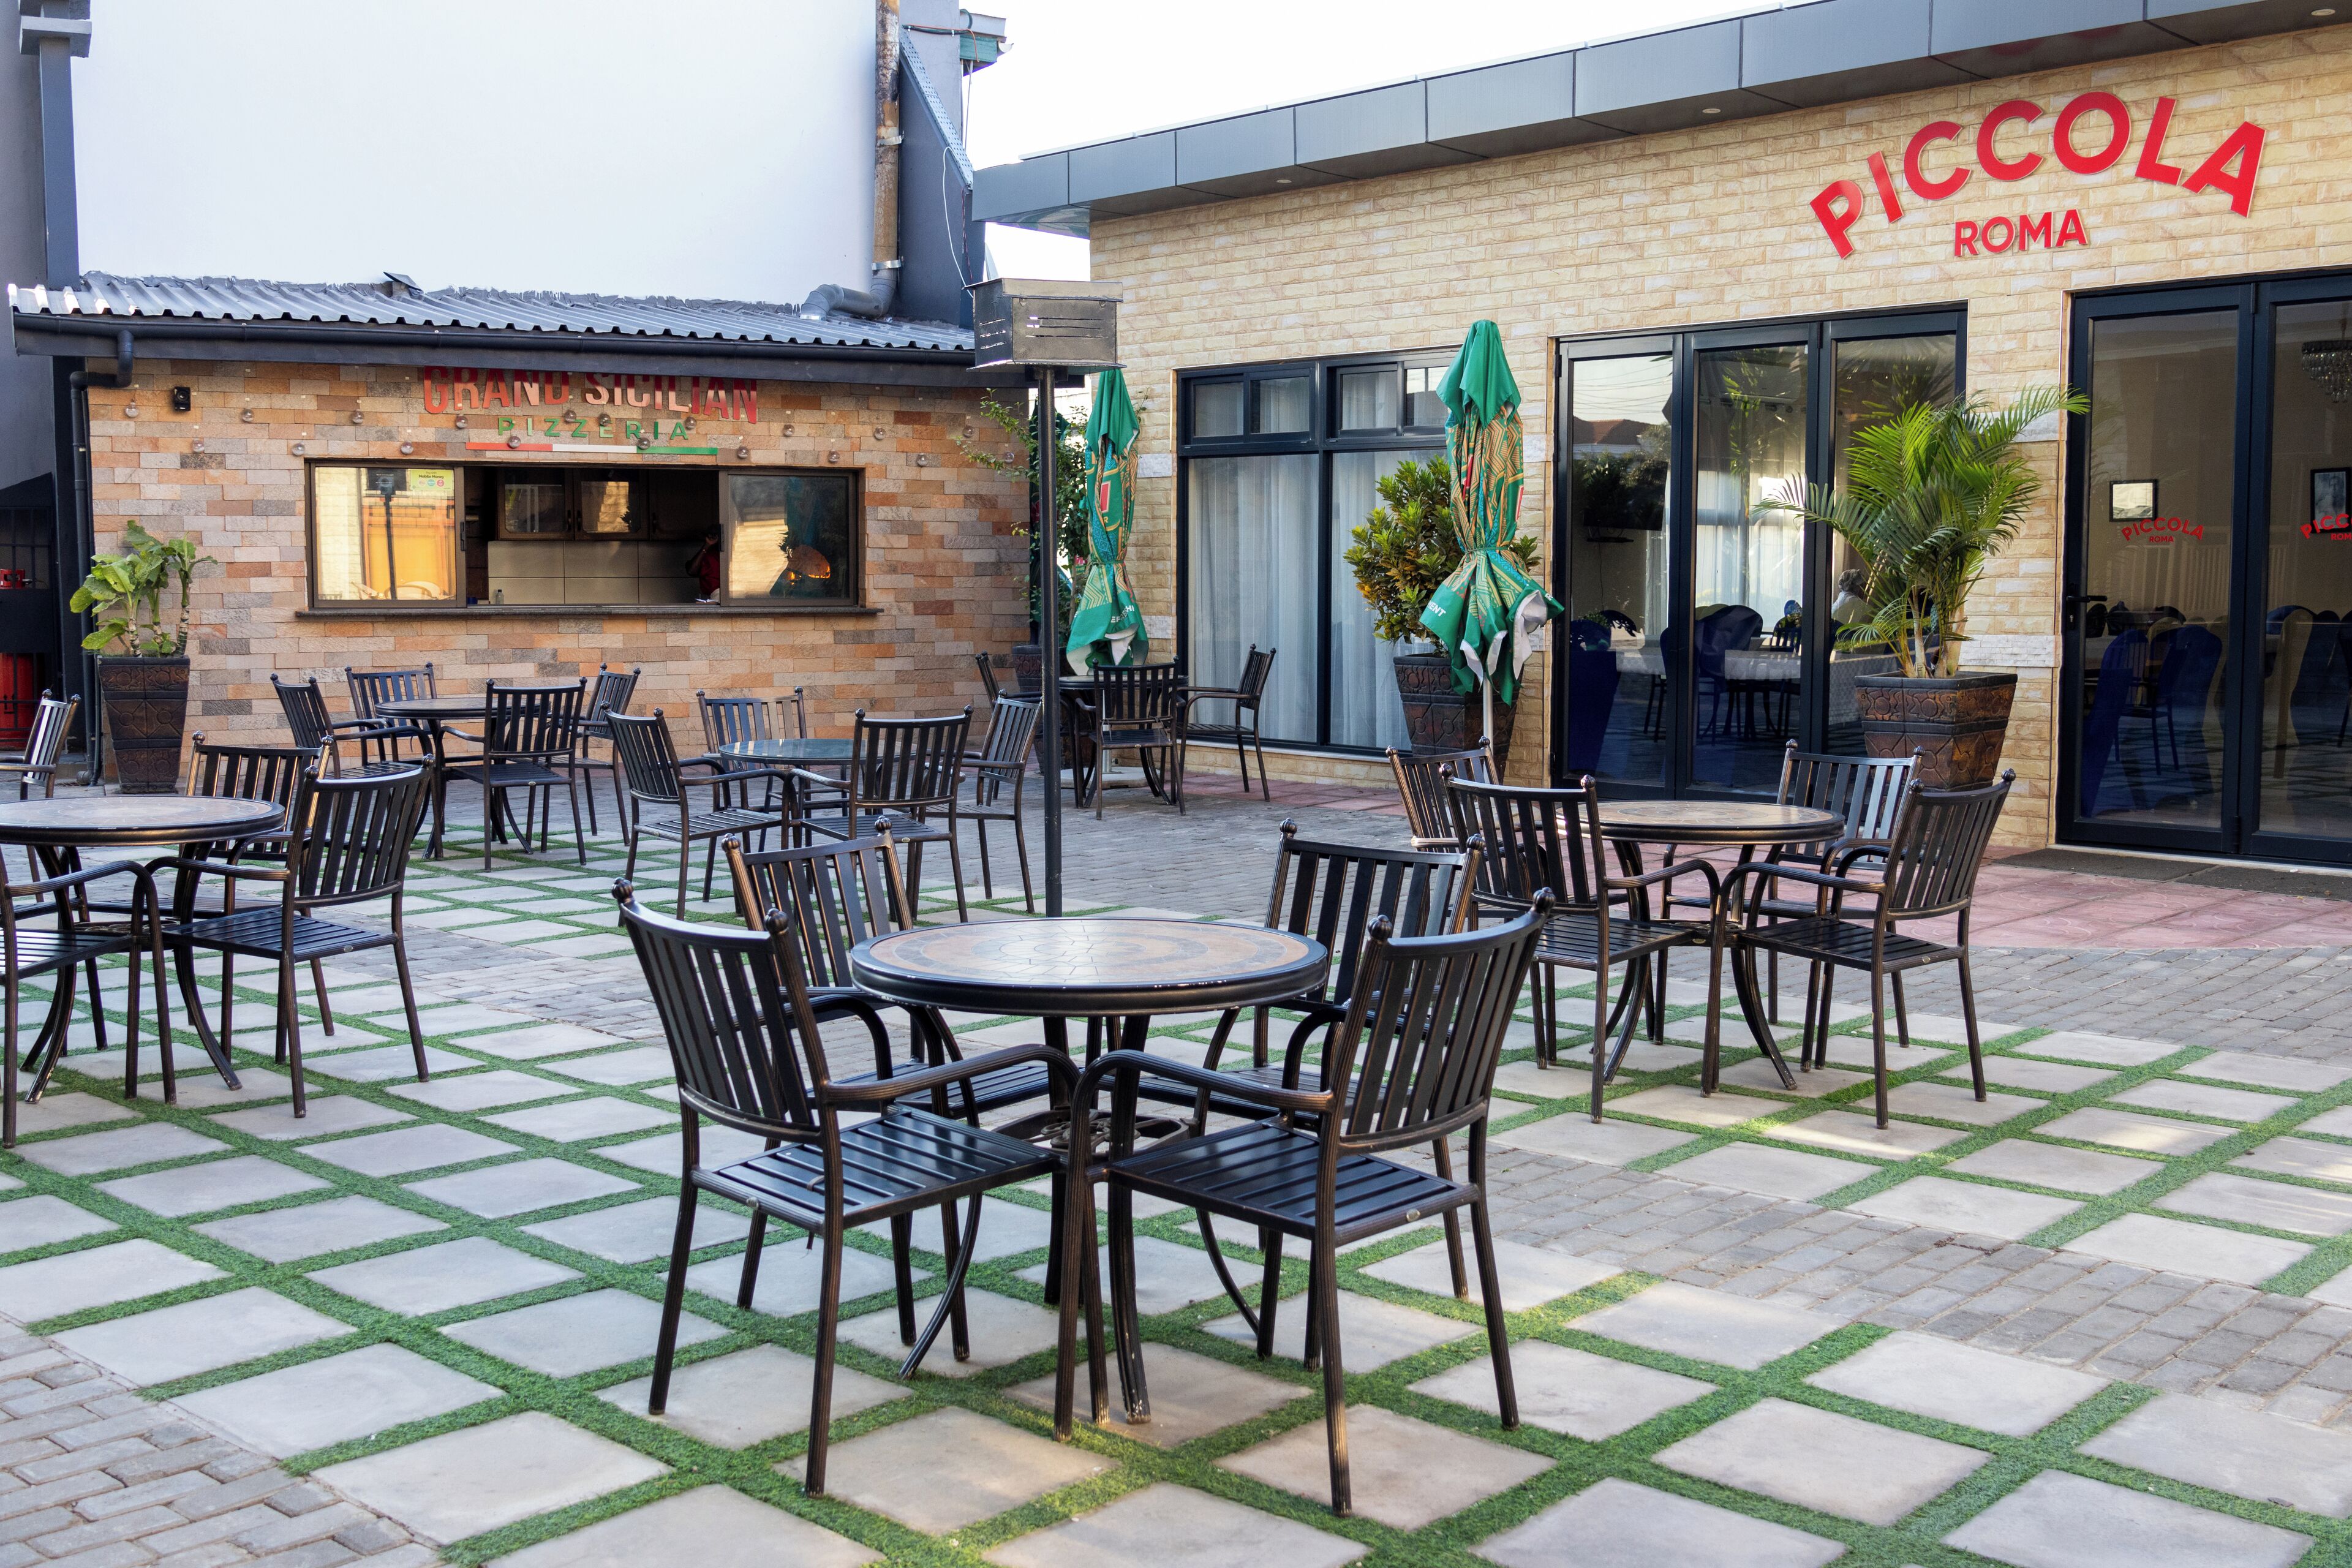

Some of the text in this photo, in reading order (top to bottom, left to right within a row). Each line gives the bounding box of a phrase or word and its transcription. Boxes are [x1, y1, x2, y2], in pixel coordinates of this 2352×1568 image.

[1809, 91, 2267, 260] PICCOLA
[1954, 209, 2089, 257] ROMA
[423, 366, 757, 424] GRAND SICILIAN
[497, 417, 688, 440] PIZZERIA
[2121, 517, 2204, 541] PICCOLA
[2300, 513, 2352, 539] PICC
